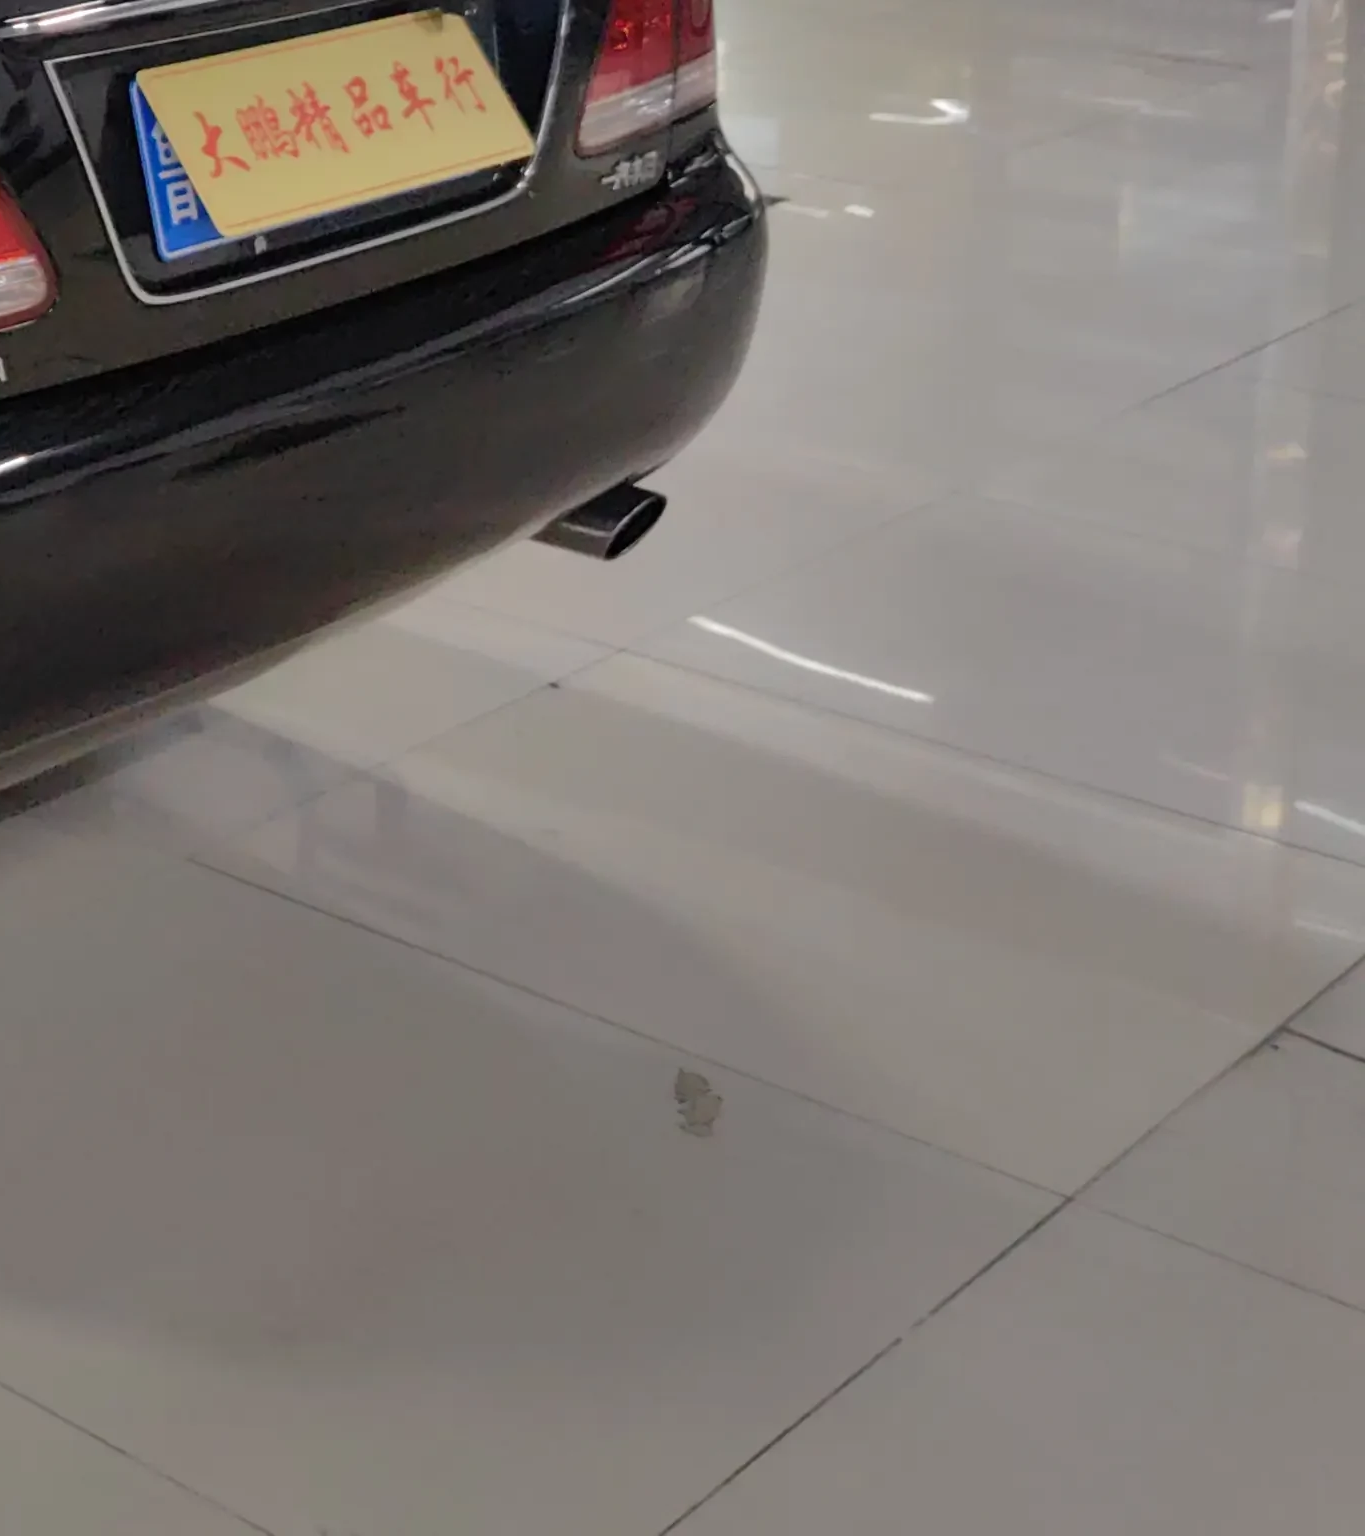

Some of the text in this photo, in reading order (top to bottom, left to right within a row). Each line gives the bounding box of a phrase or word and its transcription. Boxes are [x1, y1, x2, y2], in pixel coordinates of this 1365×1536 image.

[193, 55, 486, 178] 大鹏精品车行
